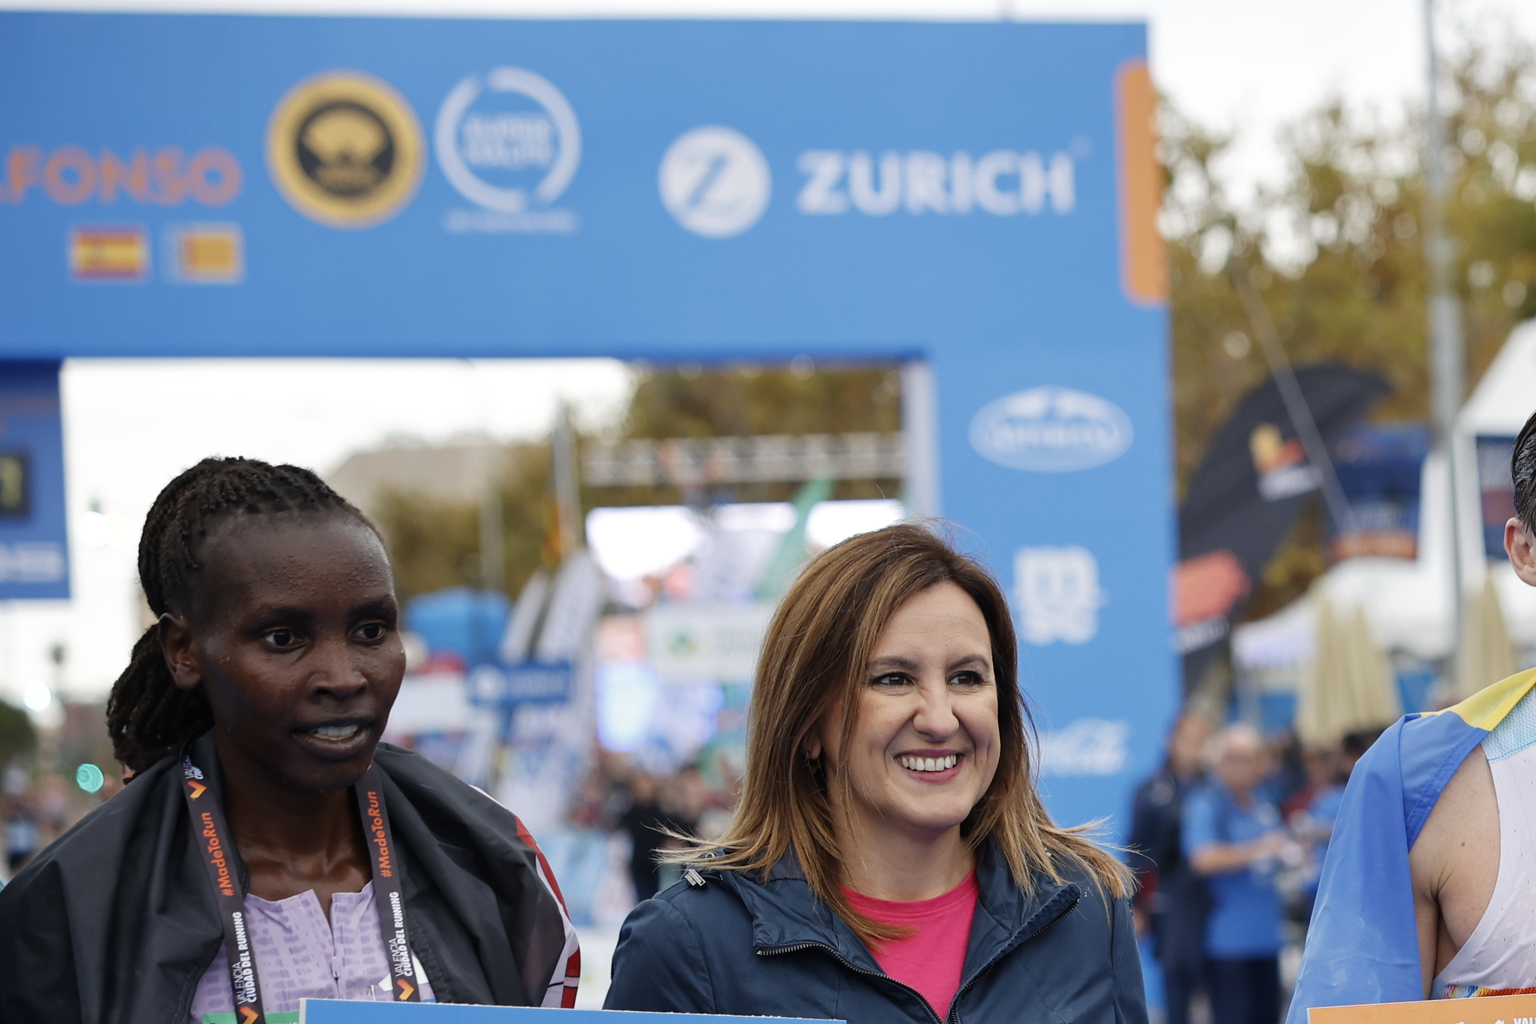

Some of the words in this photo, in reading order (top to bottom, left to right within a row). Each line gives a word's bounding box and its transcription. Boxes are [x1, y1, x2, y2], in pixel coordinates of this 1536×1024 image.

[0, 146, 243, 206] FONSO
[796, 149, 1078, 216] ZURICH
[367, 791, 392, 878] #MadeToRun
[201, 812, 235, 897] #MadeToRun
[389, 891, 404, 927] RUNNING
[232, 911, 248, 950] RUNNING
[396, 928, 407, 946] DEL
[239, 950, 251, 968] DEL
[389, 937, 403, 977] VALENCIA
[398, 946, 413, 977] CIUDAD
[231, 961, 247, 1005] VALENCIA
[242, 968, 257, 1003] CIUDAD
